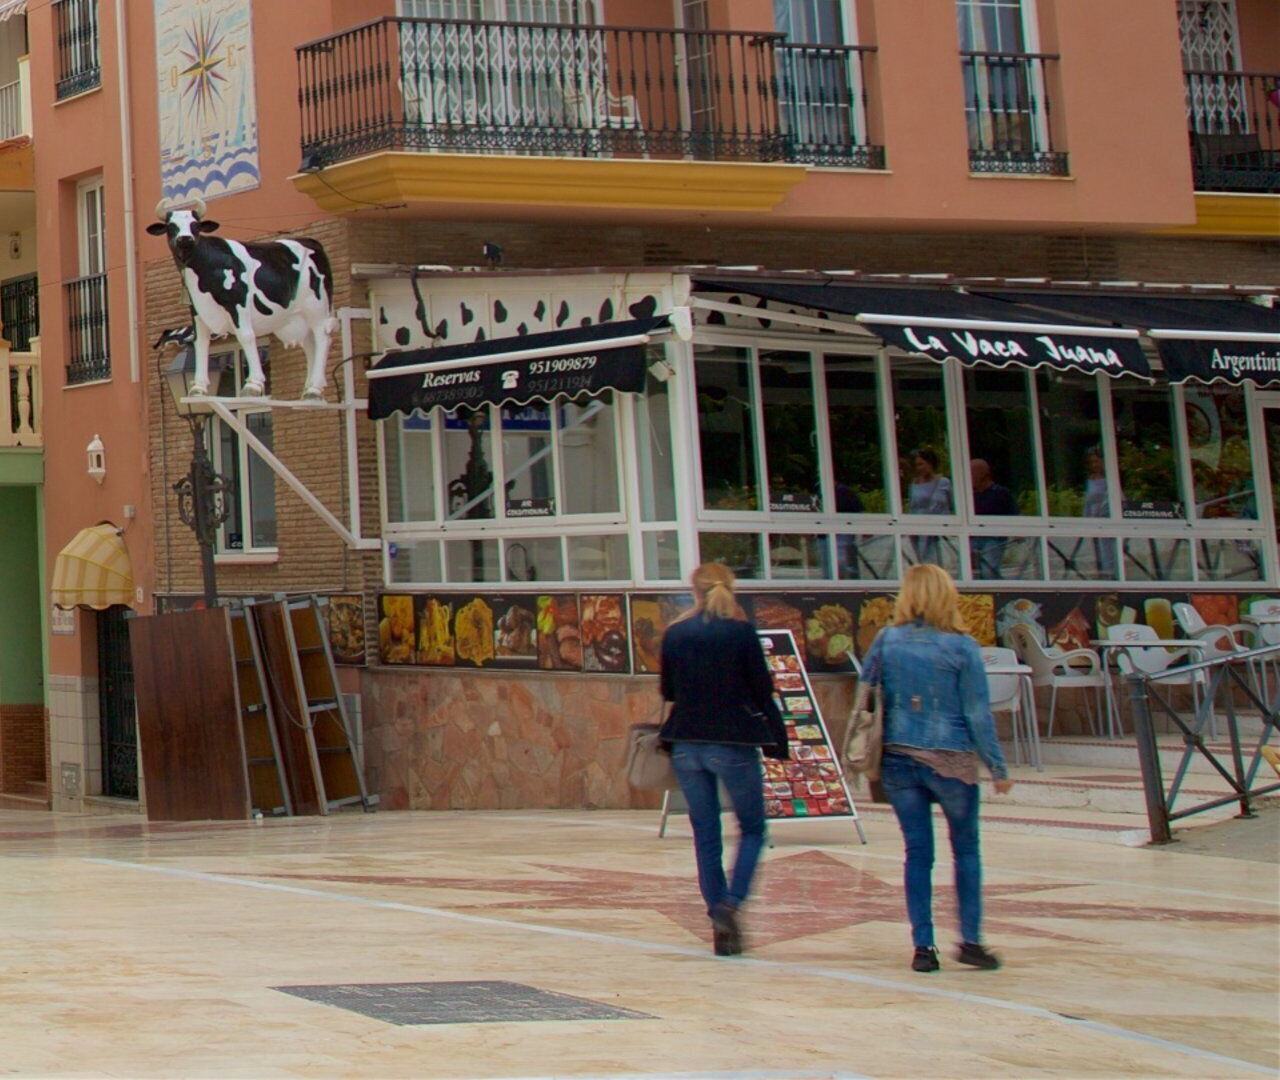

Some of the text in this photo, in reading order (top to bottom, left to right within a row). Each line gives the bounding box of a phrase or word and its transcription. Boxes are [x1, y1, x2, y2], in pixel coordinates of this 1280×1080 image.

[903, 327, 1124, 368] La Vaca Juana
[528, 355, 598, 376] 951909879
[422, 368, 481, 389] Reservas
